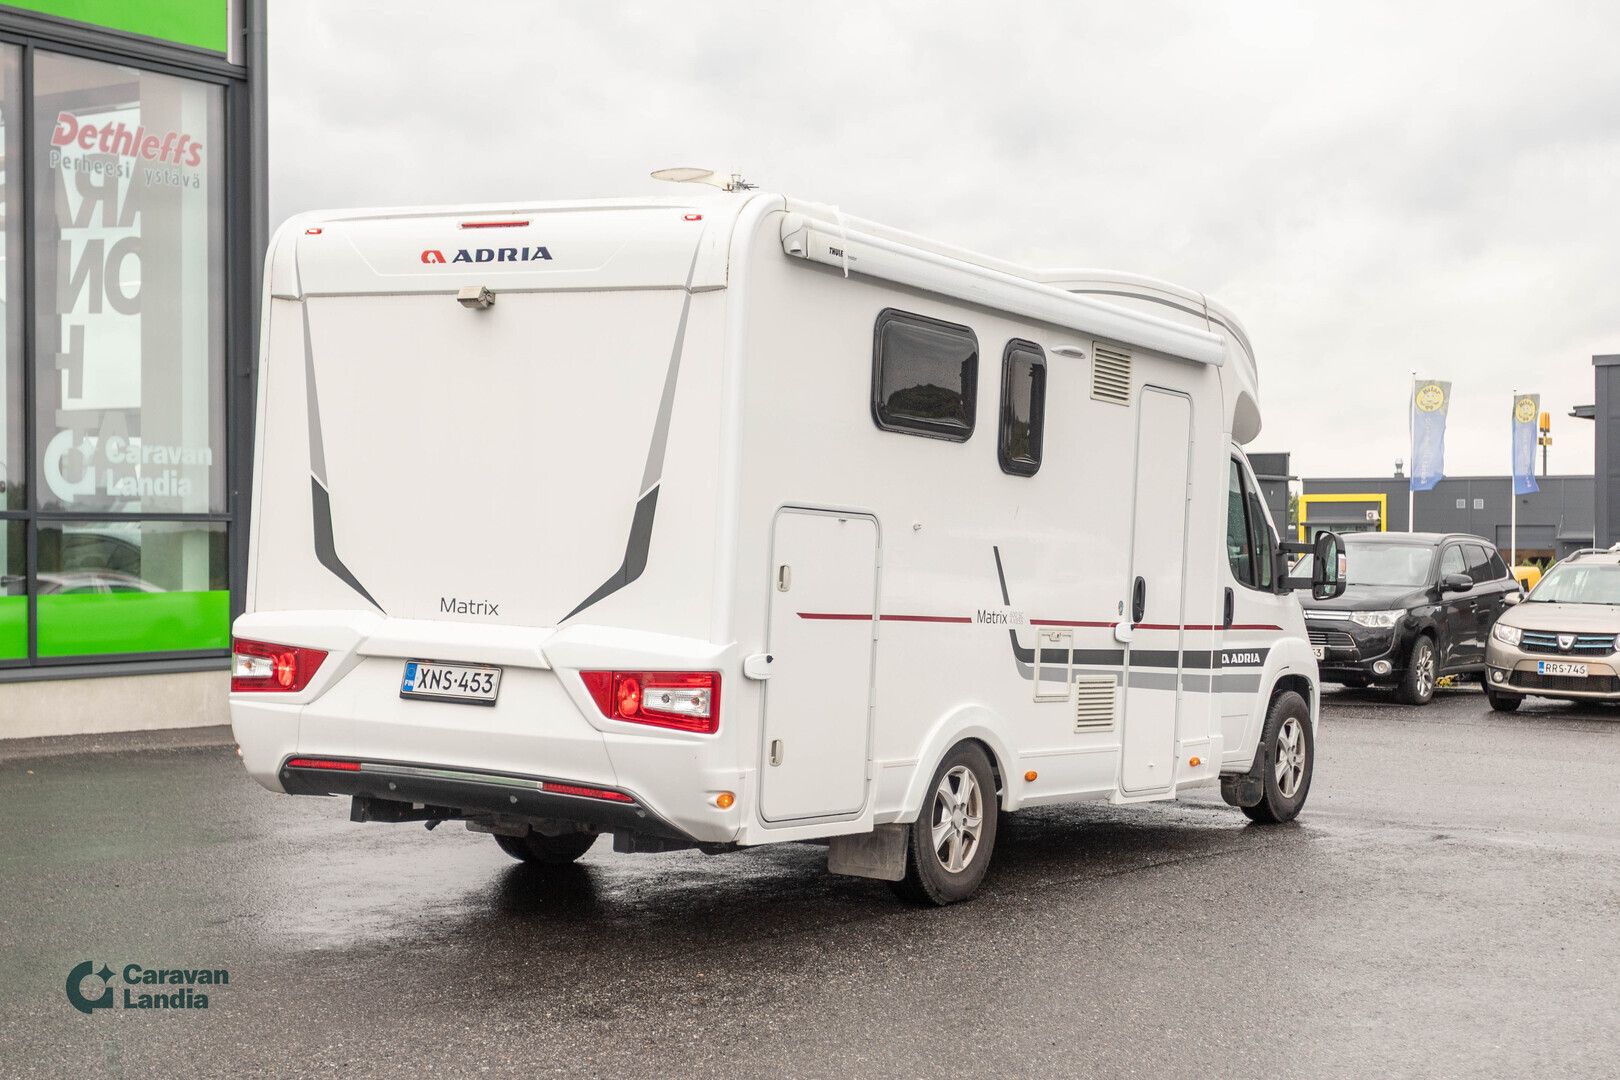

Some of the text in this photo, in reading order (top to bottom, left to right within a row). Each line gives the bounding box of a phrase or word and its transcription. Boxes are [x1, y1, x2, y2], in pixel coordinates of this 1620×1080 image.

[51, 112, 203, 167] Dethleffs
[51, 152, 200, 189] Perheesi ystävä
[452, 247, 553, 264] ADRIA
[829, 247, 844, 257] THULE
[105, 436, 212, 466] Caravan
[106, 467, 193, 496] Landia
[440, 597, 499, 616] Matrix
[977, 609, 1008, 624] Matrix
[1231, 653, 1260, 664] ADRIA
[417, 668, 494, 694] XNS-453
